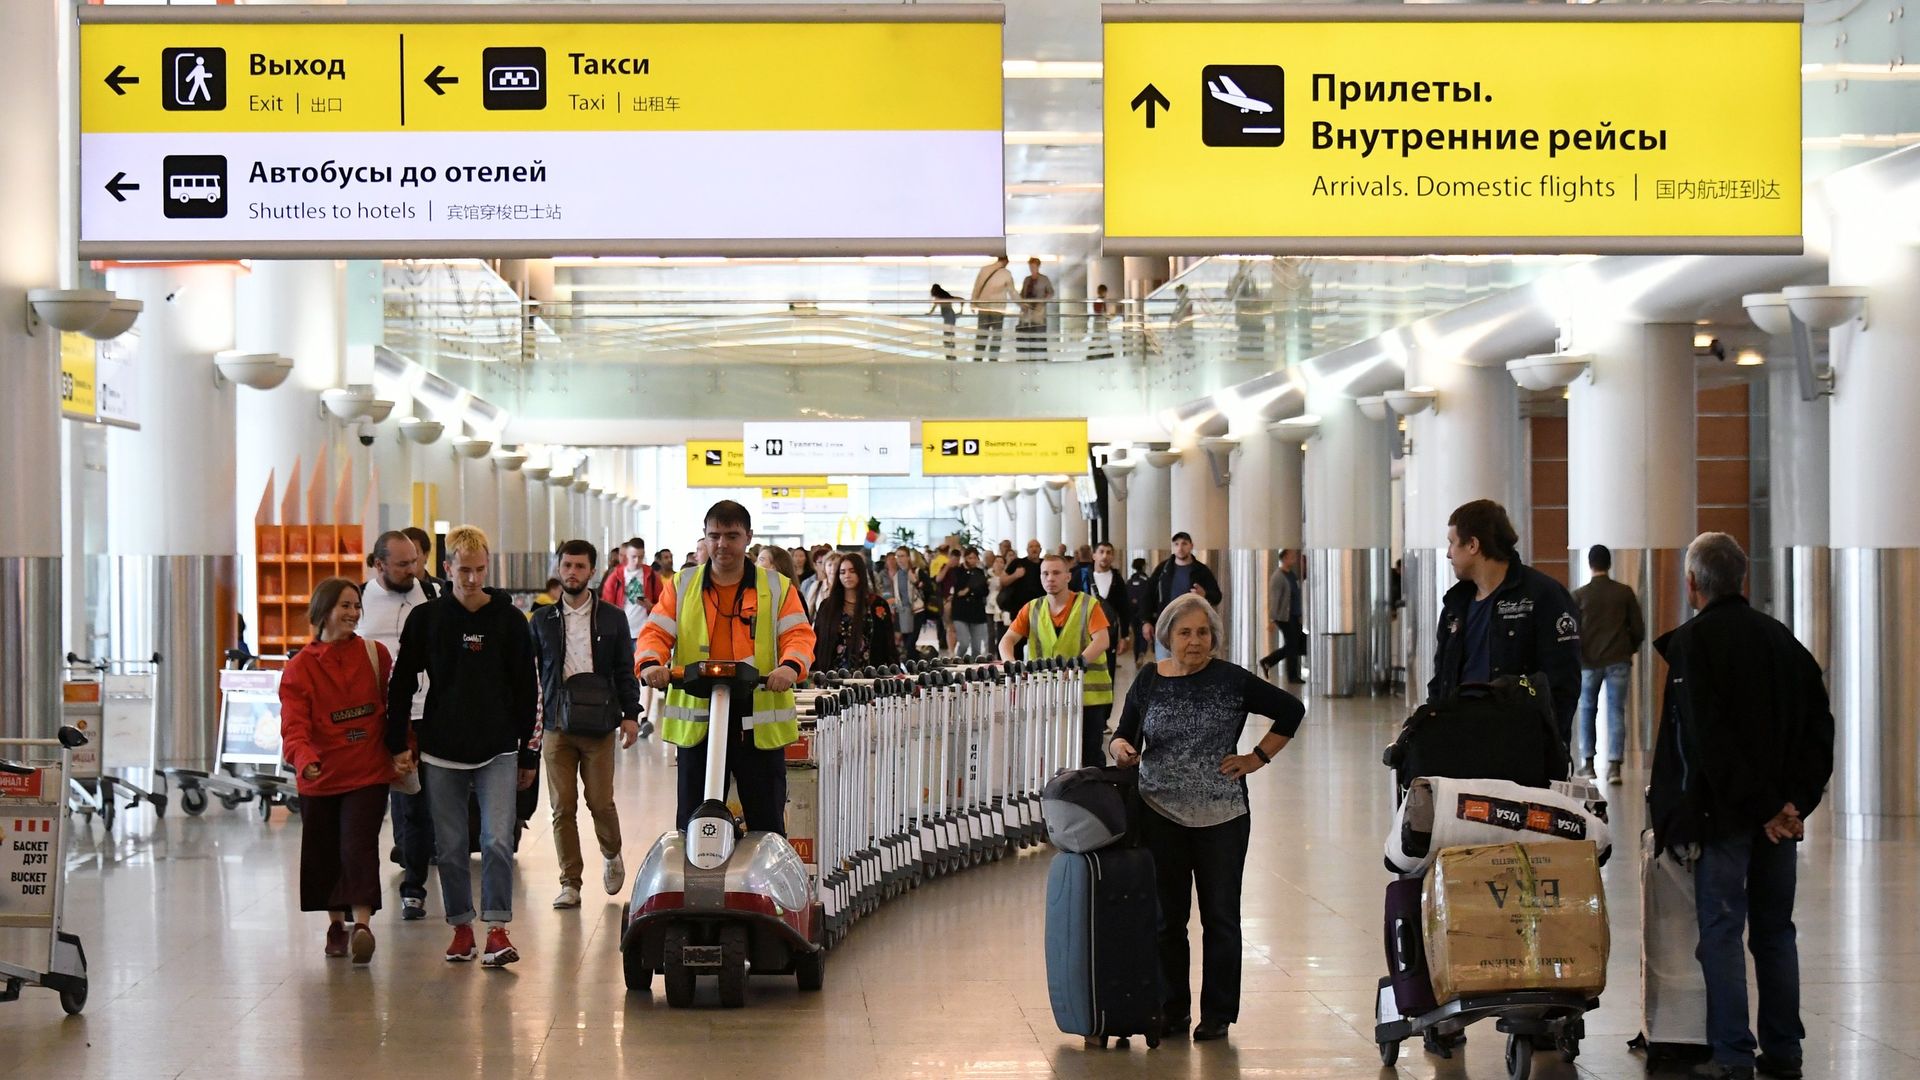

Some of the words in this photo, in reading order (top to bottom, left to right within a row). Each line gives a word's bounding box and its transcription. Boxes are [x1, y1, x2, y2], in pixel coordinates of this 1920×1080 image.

[249, 53, 346, 81] Выход
[567, 52, 650, 76] Такси
[1311, 73, 1493, 110] Прилеты.
[249, 94, 284, 112] Exit
[310, 96, 342, 113] 出口
[567, 93, 605, 111] Taxi
[633, 95, 681, 113] 出租车
[1311, 120, 1540, 159] Внутренние
[1548, 120, 1667, 159] рейсы
[248, 159, 393, 190] Автобусы
[399, 165, 437, 188] до
[444, 159, 547, 184] отелей
[1311, 174, 1409, 198] Arrivals.
[1416, 174, 1533, 197] Domestic
[1539, 174, 1616, 203] flights
[1656, 179, 1781, 200] 国内航班到达
[248, 201, 327, 220] Shuttles
[331, 204, 352, 220] to
[357, 201, 416, 220] hotels
[447, 203, 562, 221] 宾馆穿梭巴士站
[964, 440, 977, 454] D
[0, 776, 22, 787] ИНАЛ
[1496, 808, 1521, 823] VISA
[1557, 818, 1581, 834] VISA
[13, 840, 49, 851] БАСКЕТ
[23, 853, 48, 866] ДУЭТ
[11, 872, 47, 884] BUCKET
[22, 885, 47, 896] DUET
